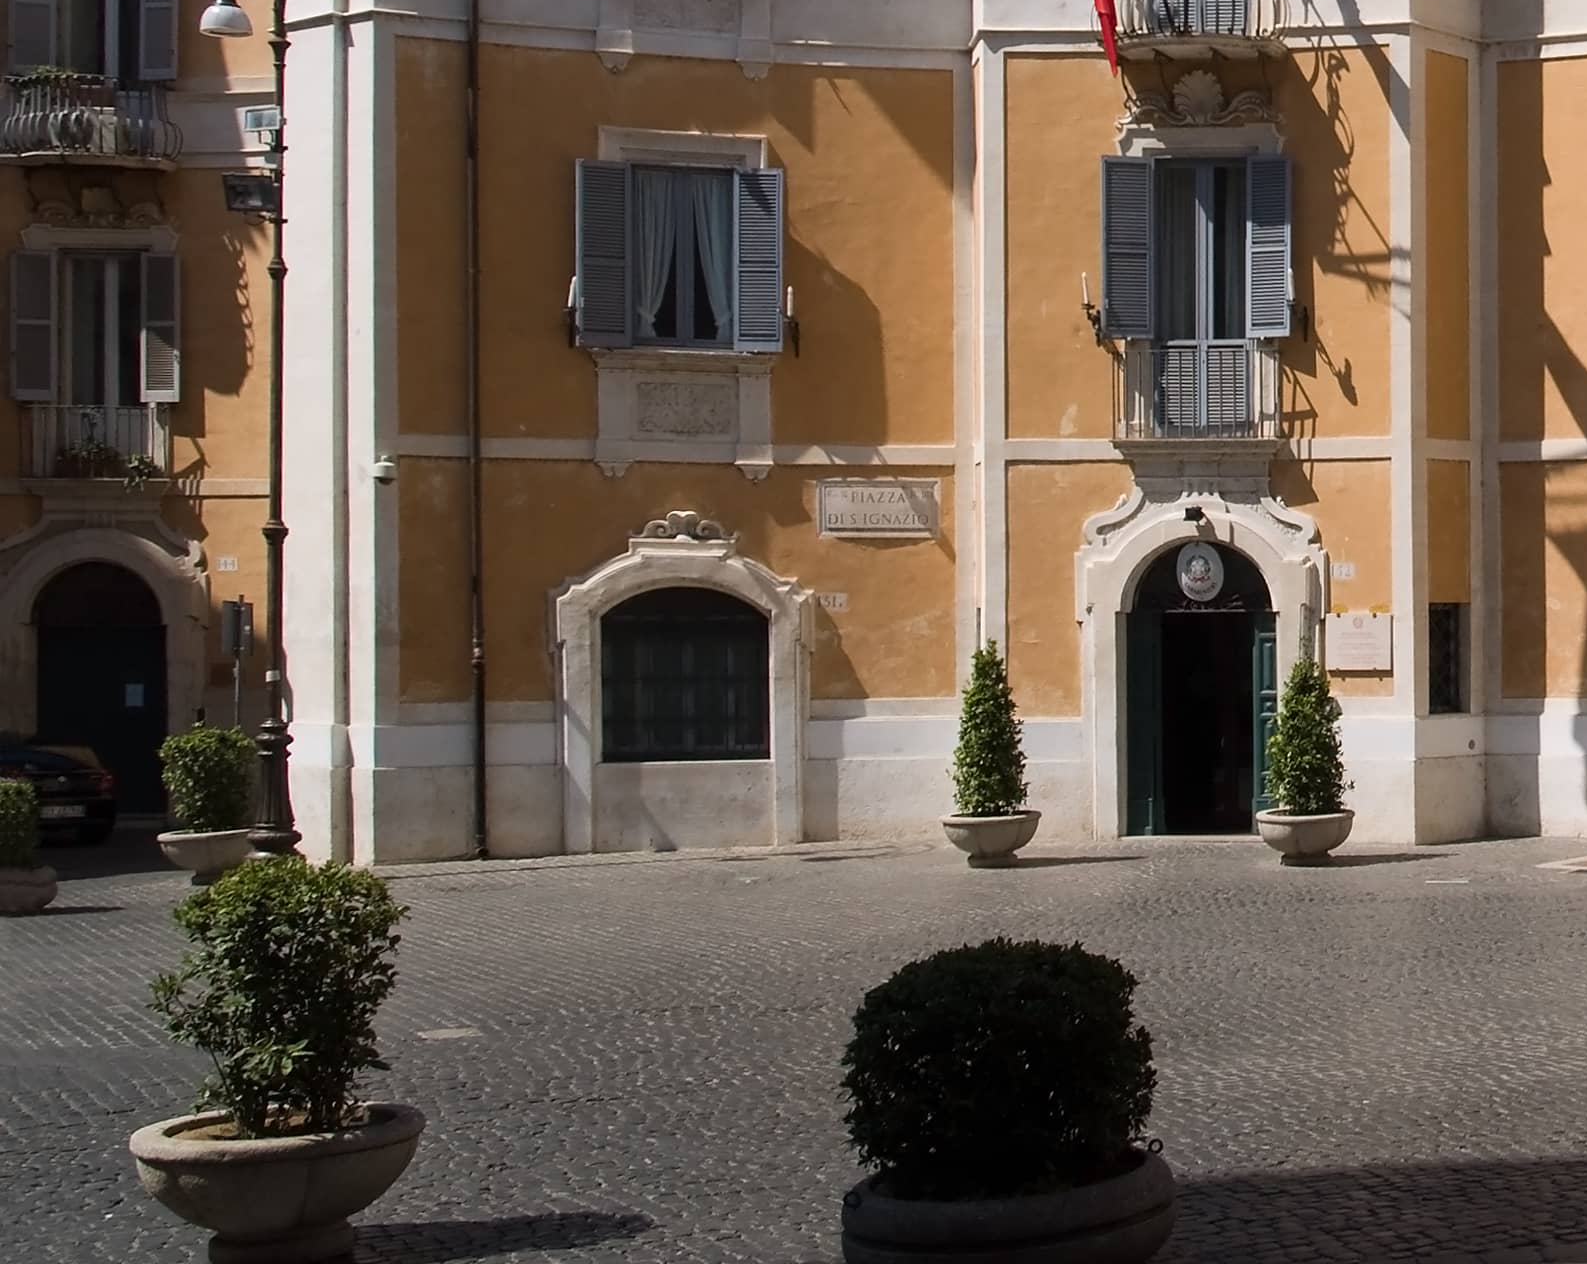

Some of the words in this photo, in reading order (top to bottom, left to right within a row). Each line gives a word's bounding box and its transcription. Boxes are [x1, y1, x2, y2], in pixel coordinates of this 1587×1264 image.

[851, 491, 906, 504] PIAZZA
[828, 513, 844, 525] DI
[863, 513, 929, 525] IGNAZIO
